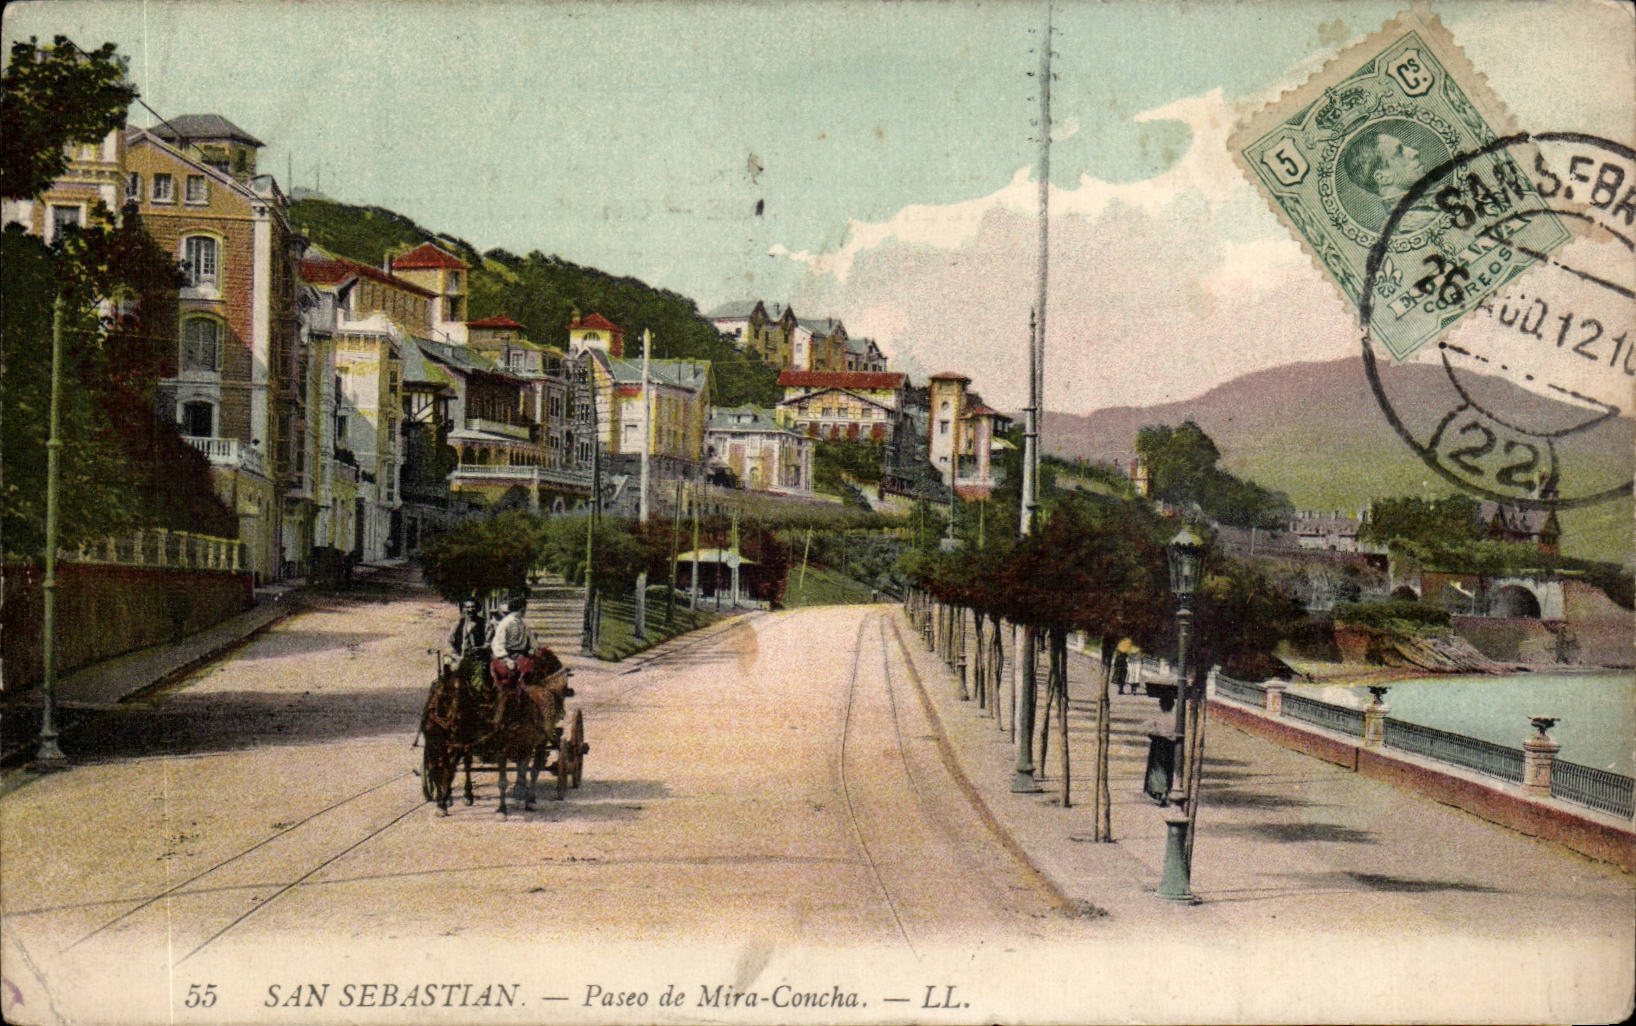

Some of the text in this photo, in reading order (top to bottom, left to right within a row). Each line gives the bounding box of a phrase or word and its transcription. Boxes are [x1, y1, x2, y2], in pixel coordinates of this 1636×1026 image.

[1275, 148, 1299, 177] 5
[1435, 160, 1525, 230] SAN
[1414, 254, 1471, 306] 26
[1556, 312, 1604, 361] 12
[1423, 247, 1513, 313] CORREOS
[1448, 421, 1540, 493] 22
